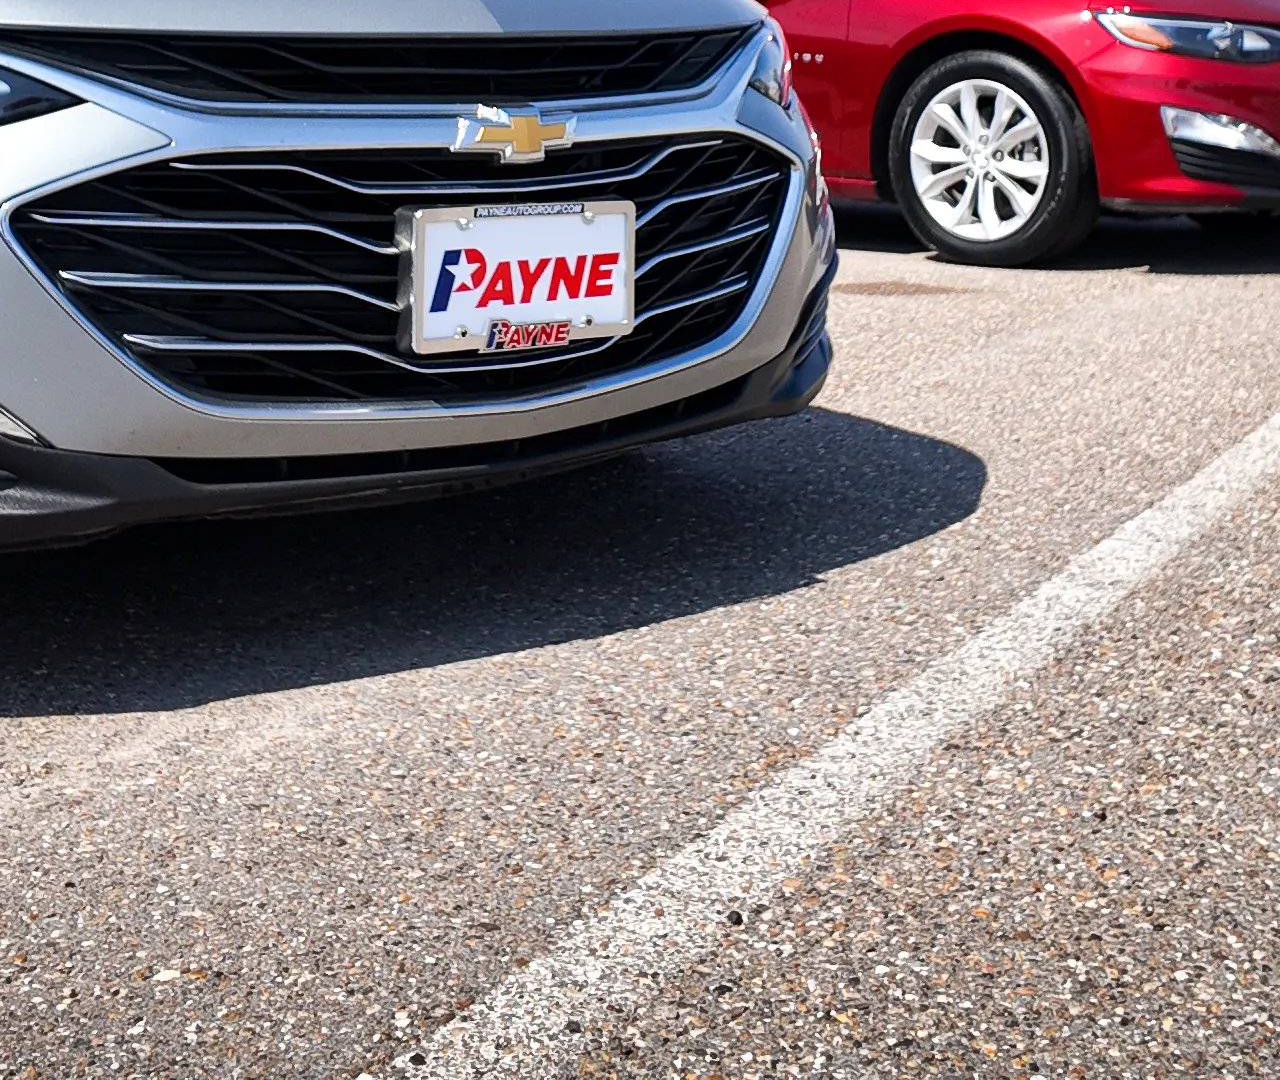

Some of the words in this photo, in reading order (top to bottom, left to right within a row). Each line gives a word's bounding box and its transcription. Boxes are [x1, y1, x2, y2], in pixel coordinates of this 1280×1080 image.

[477, 203, 582, 217] PAYNEAUTOGROUP.COM
[429, 248, 620, 313] PAYNE
[486, 322, 569, 348] PAYNE
